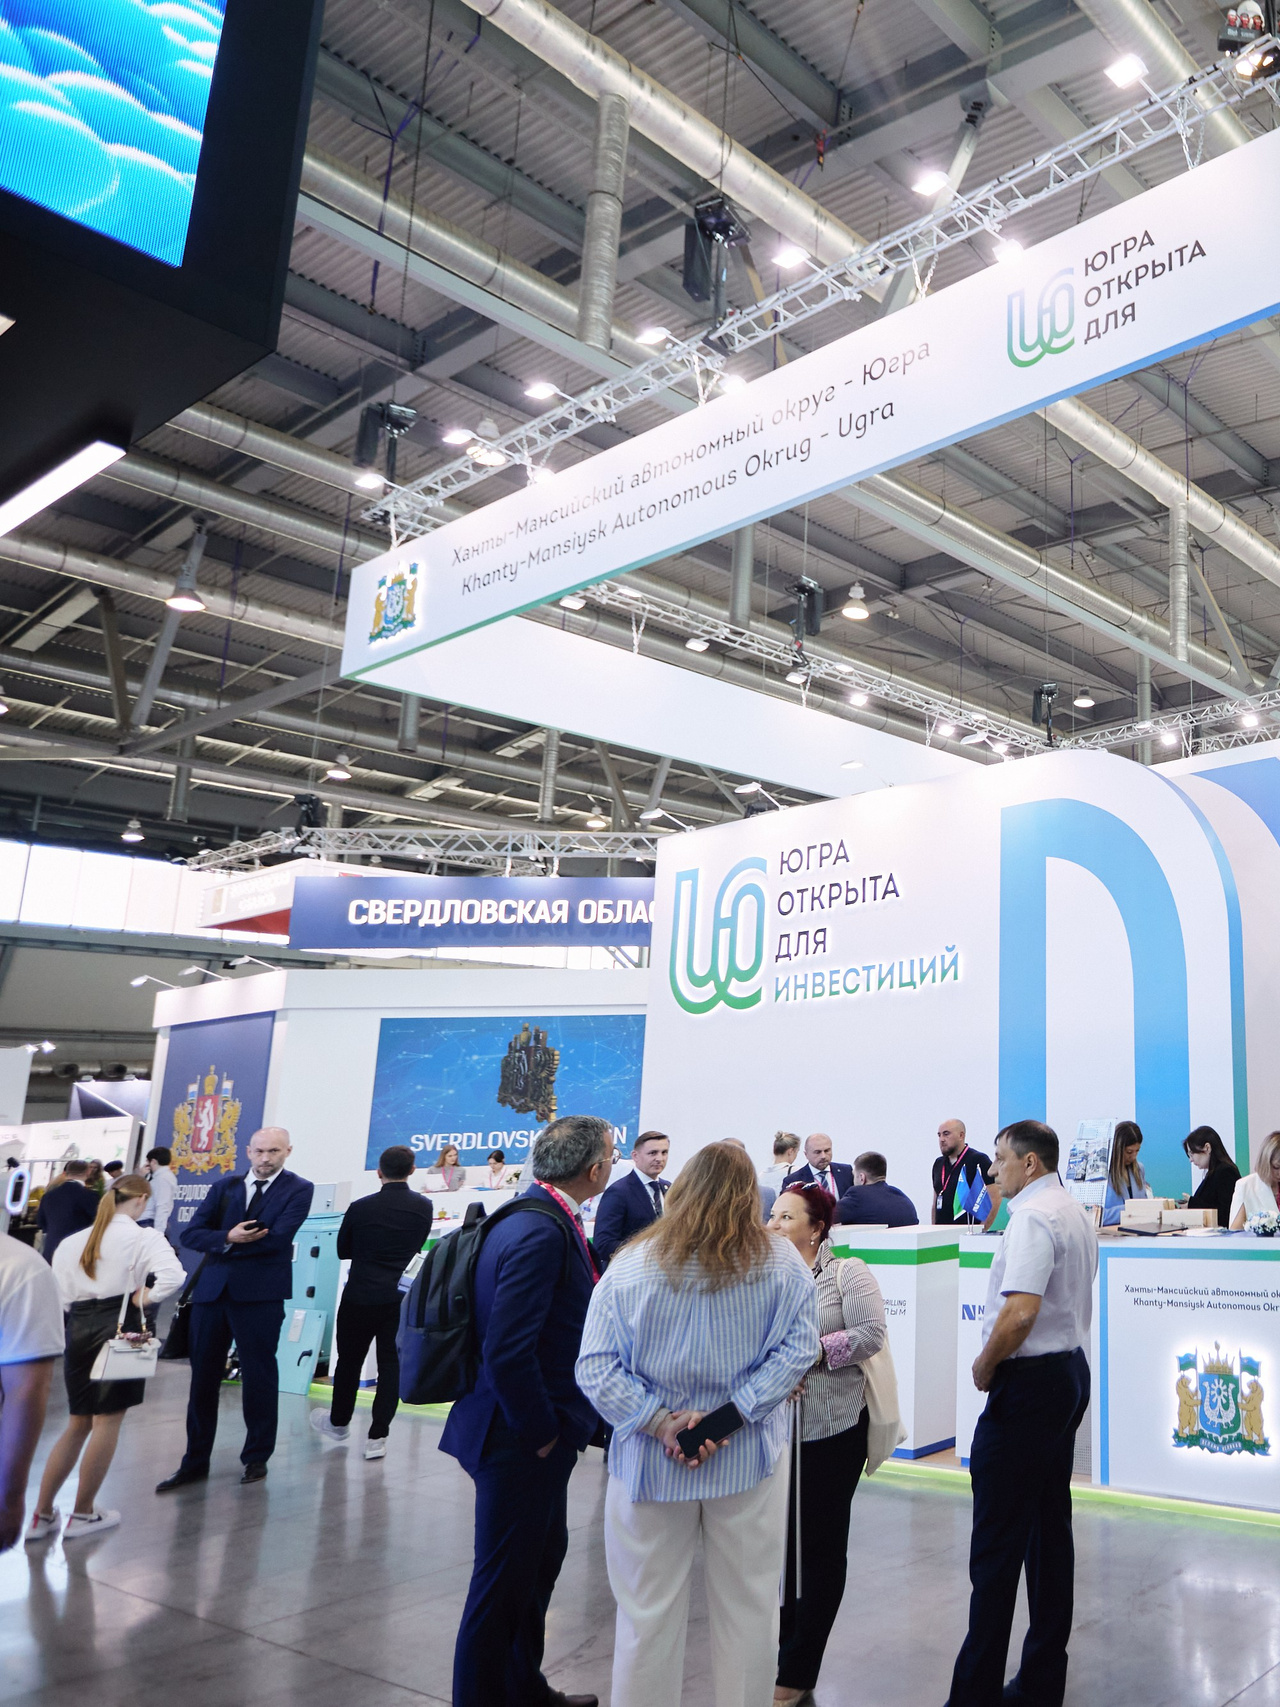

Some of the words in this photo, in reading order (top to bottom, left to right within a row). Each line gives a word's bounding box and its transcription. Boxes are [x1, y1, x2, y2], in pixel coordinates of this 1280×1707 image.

[1084, 230, 1155, 277] ЮГРА
[1084, 239, 1207, 308] ОТКРЫТА
[1084, 302, 1136, 345] ДЛЯ
[452, 475, 625, 566] Ханты-Мансийский
[630, 414, 764, 489] автономный
[771, 385, 836, 426] округ
[863, 342, 931, 386] Югра
[461, 520, 608, 595] Khanty-Mansiysk
[612, 467, 738, 534] Autonomous
[744, 438, 812, 478] Okrug
[838, 402, 895, 439] Ugra
[780, 839, 850, 875] ЮГРА
[348, 899, 569, 927] СВЕРДЛОВСКАЯ
[777, 872, 900, 916] ОТКРЫТА
[775, 928, 827, 963] ДЛЯ
[774, 944, 959, 1003] ИНВЕСТИЦИЙ
[411, 1130, 541, 1151] SVERDLOVSK
[1124, 1285, 1209, 1297] Ханты-Мансийский
[1211, 1286, 1269, 1299] автономный
[1133, 1297, 1205, 1310] Khanty-Mansiysk
[1206, 1300, 1261, 1312] Autonomous
